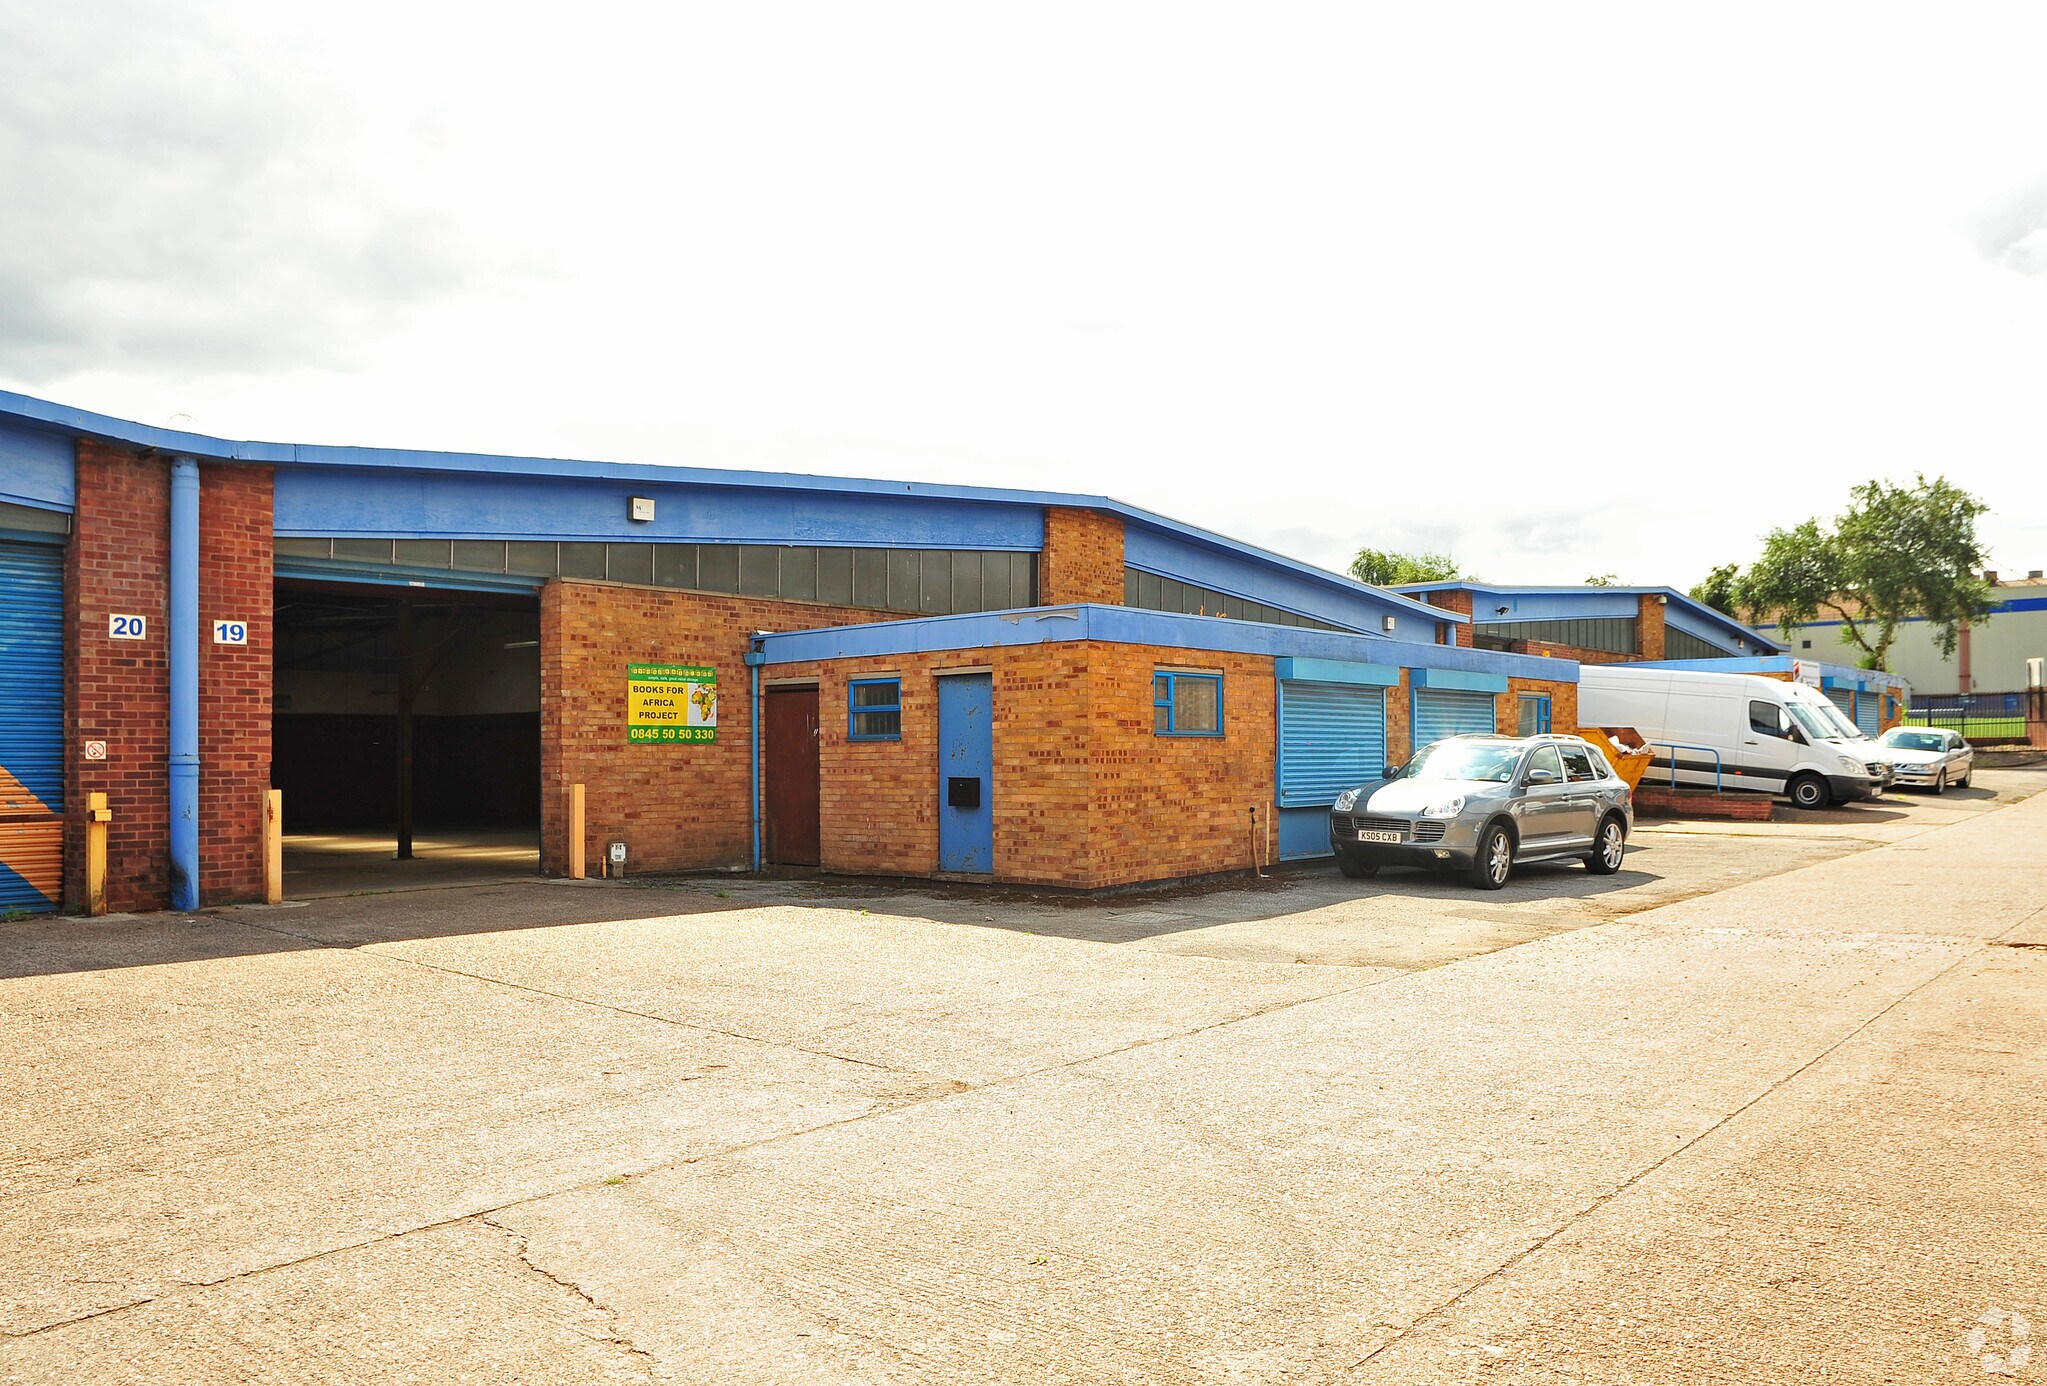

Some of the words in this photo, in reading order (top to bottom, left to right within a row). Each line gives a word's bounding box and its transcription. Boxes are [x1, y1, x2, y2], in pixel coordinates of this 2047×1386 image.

[113, 617, 143, 636] 20
[217, 624, 245, 641] 19
[633, 685, 664, 694] BOOKS
[666, 686, 684, 694] FOR
[639, 711, 678, 719] PROJECT
[631, 728, 659, 739] 0845
[662, 728, 675, 739] 50
[678, 729, 692, 739] 50
[695, 729, 714, 739] 330
[1361, 831, 1380, 840] KS05
[1382, 833, 1397, 841] CXB
